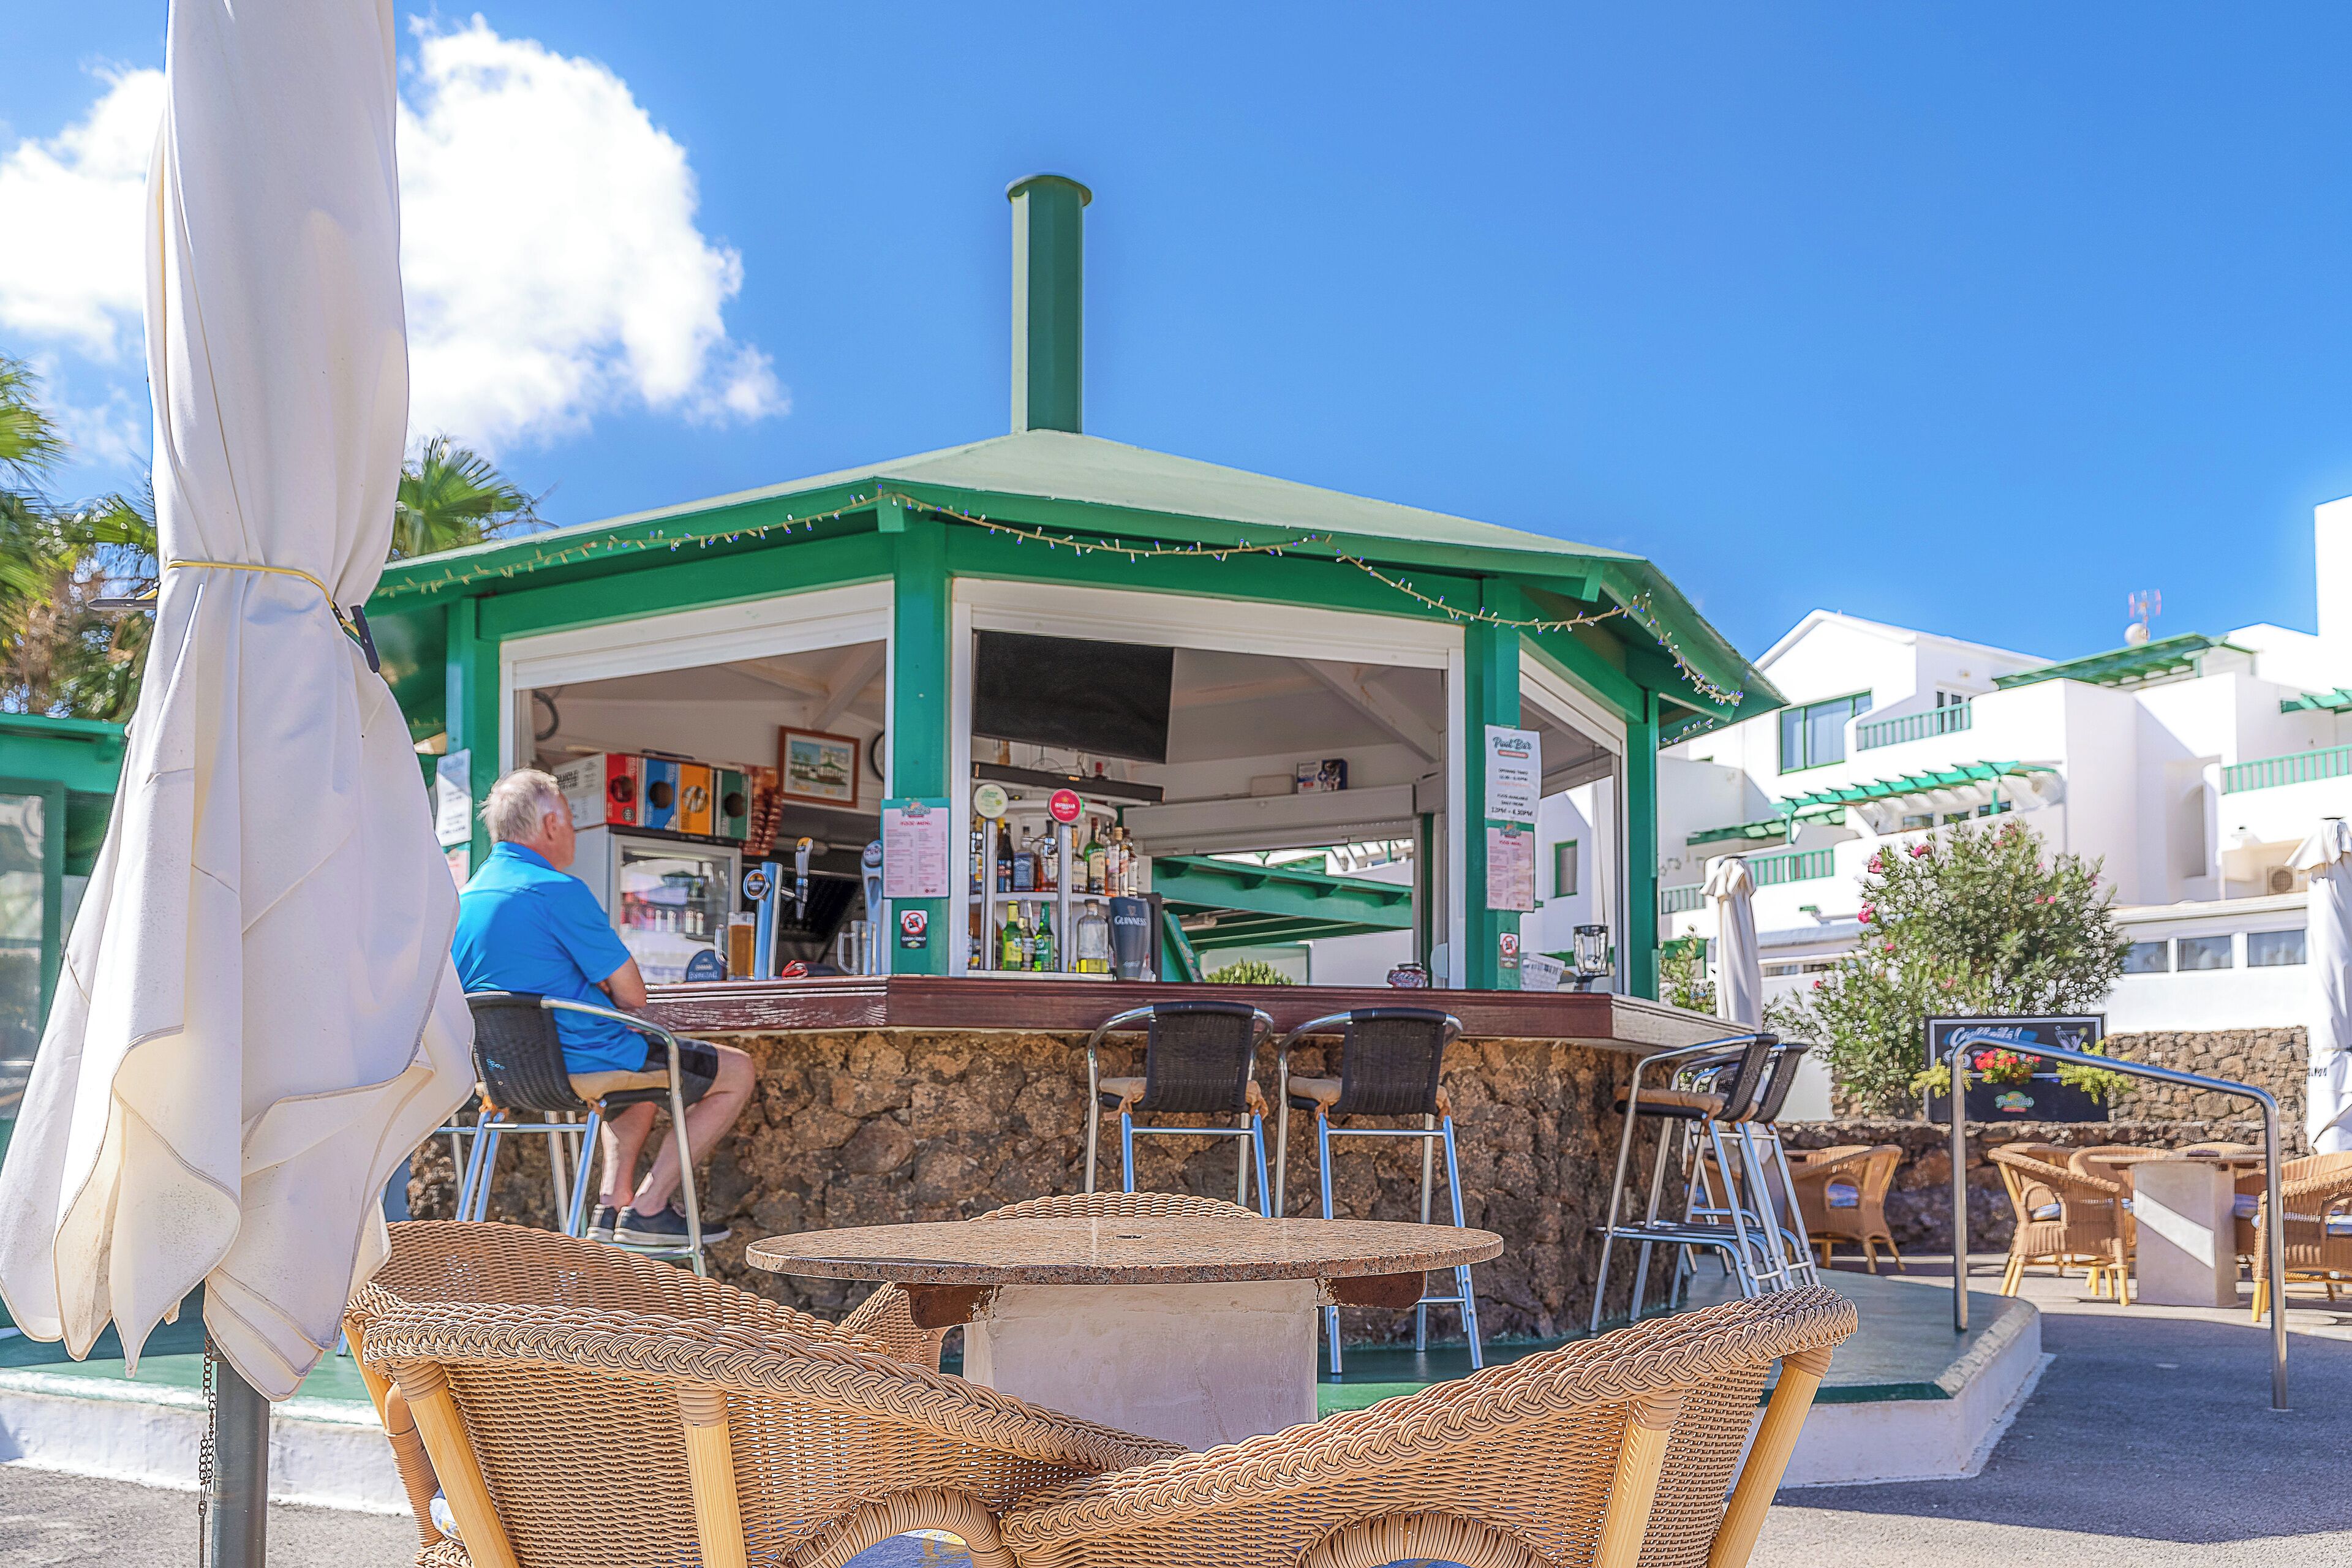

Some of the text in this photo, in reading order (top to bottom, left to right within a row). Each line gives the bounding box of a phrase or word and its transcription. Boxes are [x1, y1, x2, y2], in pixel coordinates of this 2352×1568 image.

[1493, 736, 1532, 750] Pool Bar
[1115, 916, 1147, 926] GUINNESS
